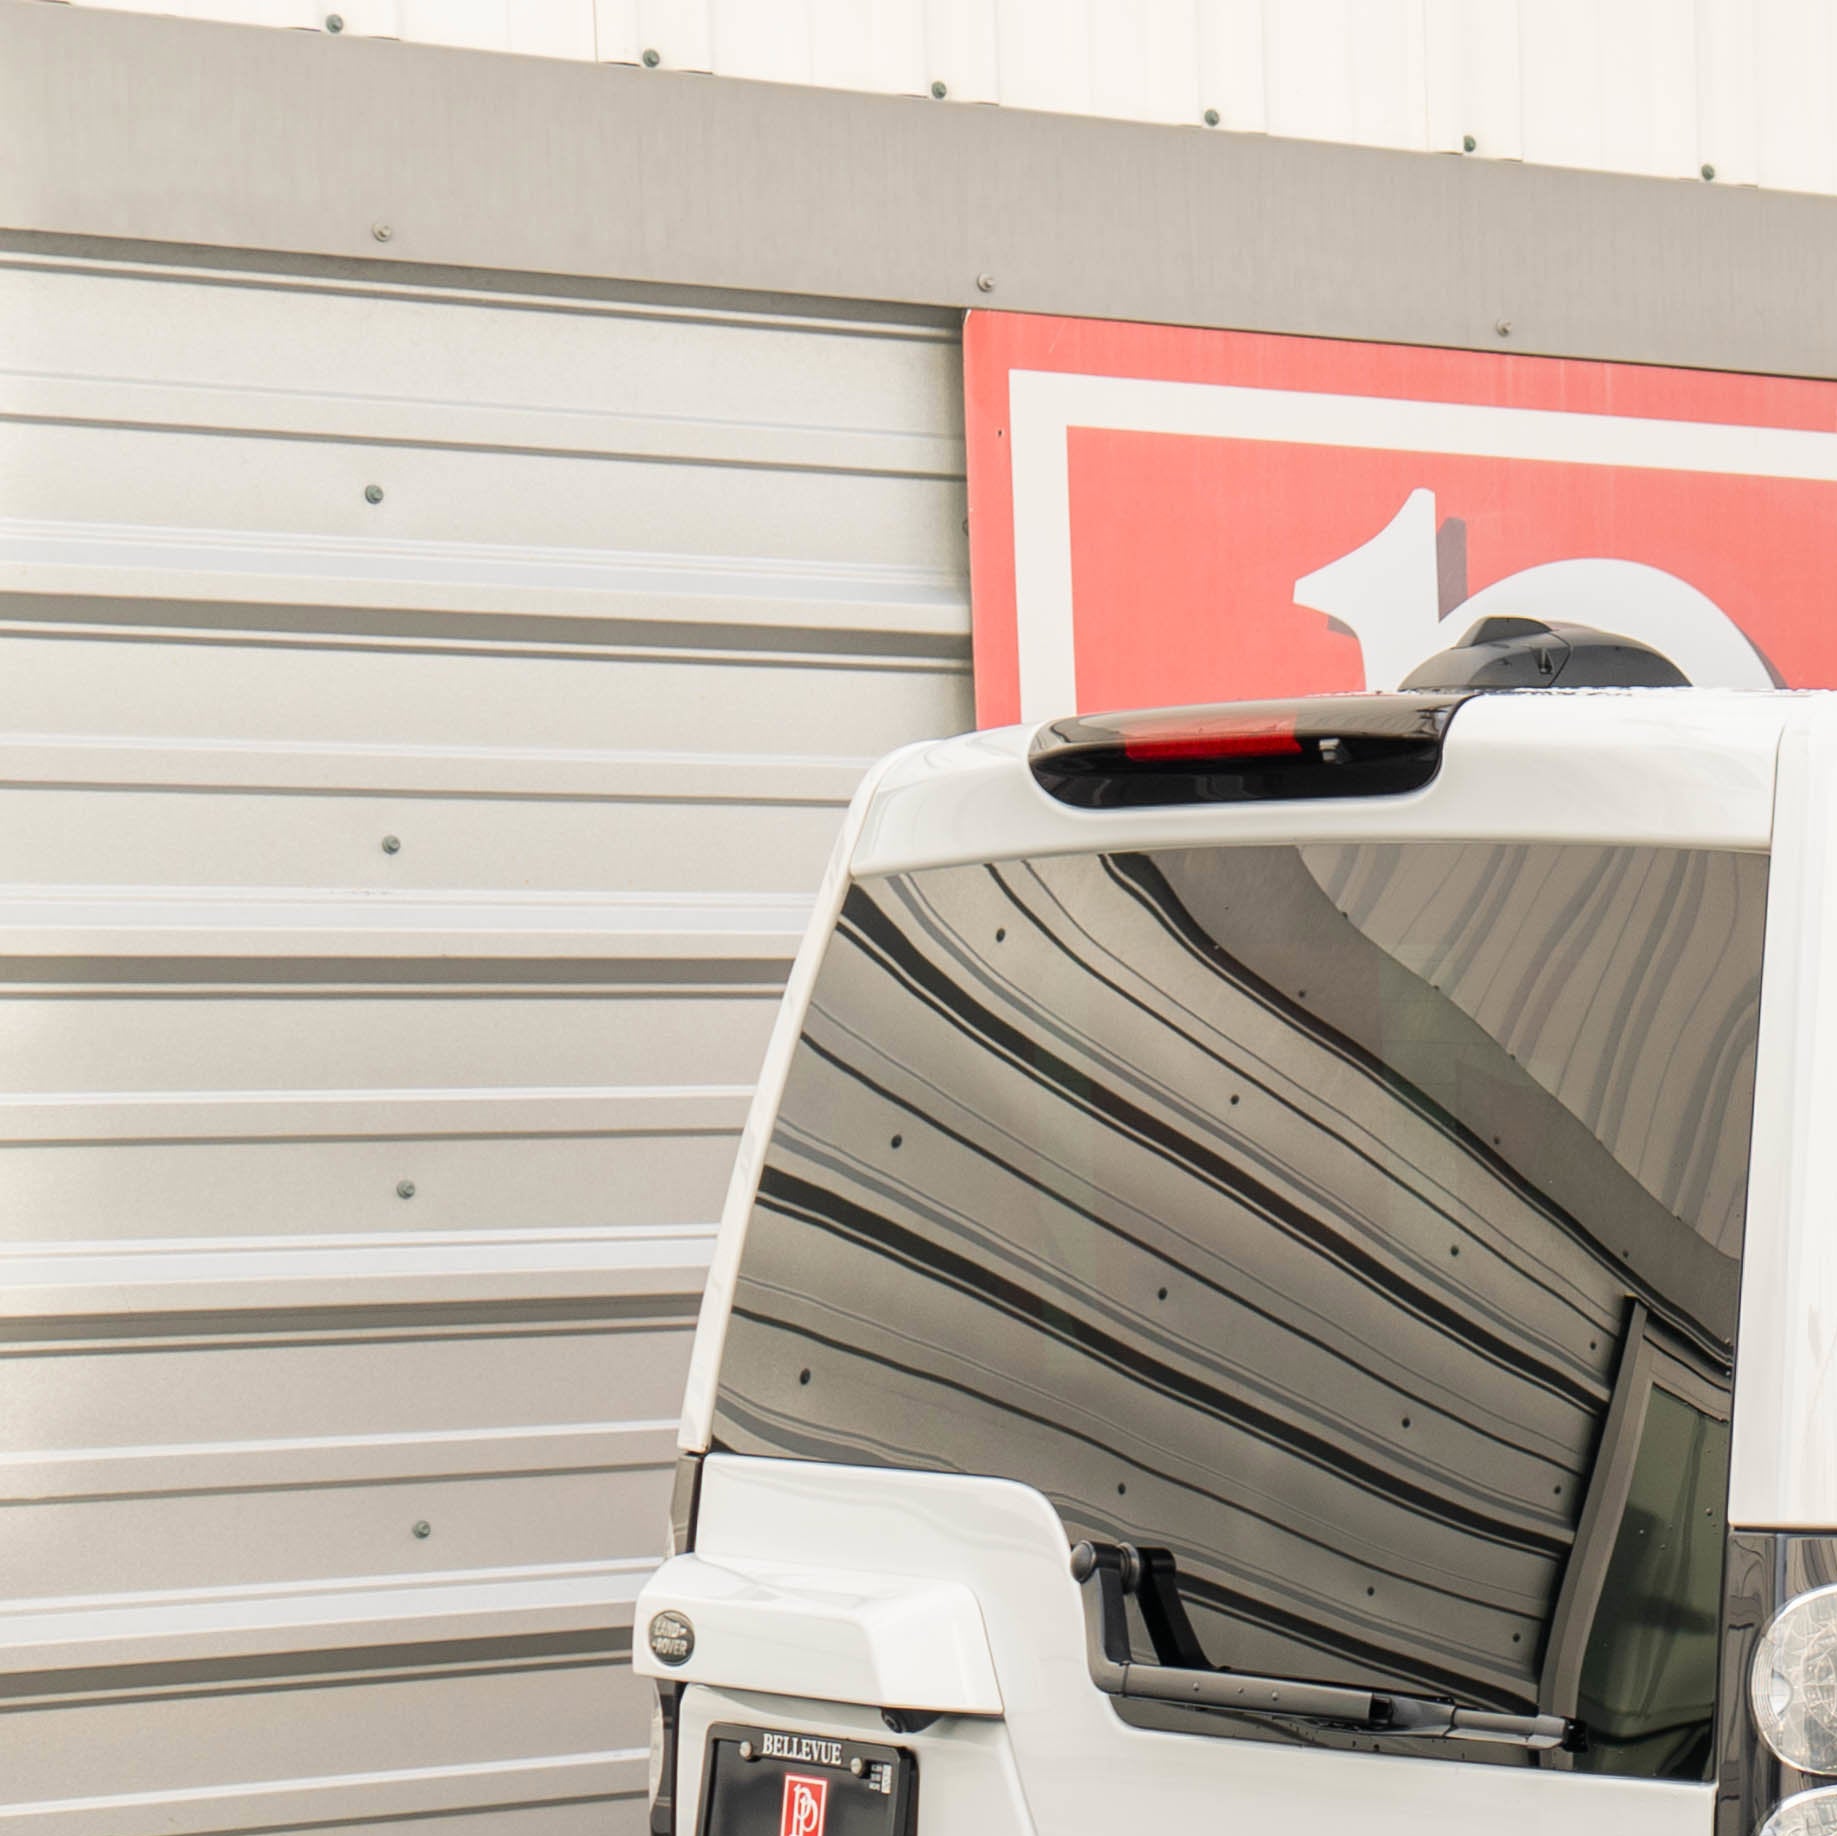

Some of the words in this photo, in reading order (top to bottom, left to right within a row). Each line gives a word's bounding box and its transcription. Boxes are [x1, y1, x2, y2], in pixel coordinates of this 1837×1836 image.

[654, 1620, 681, 1638] LAND
[656, 1638, 688, 1656] ROVER
[762, 1733, 843, 1765] BELLEVUE
